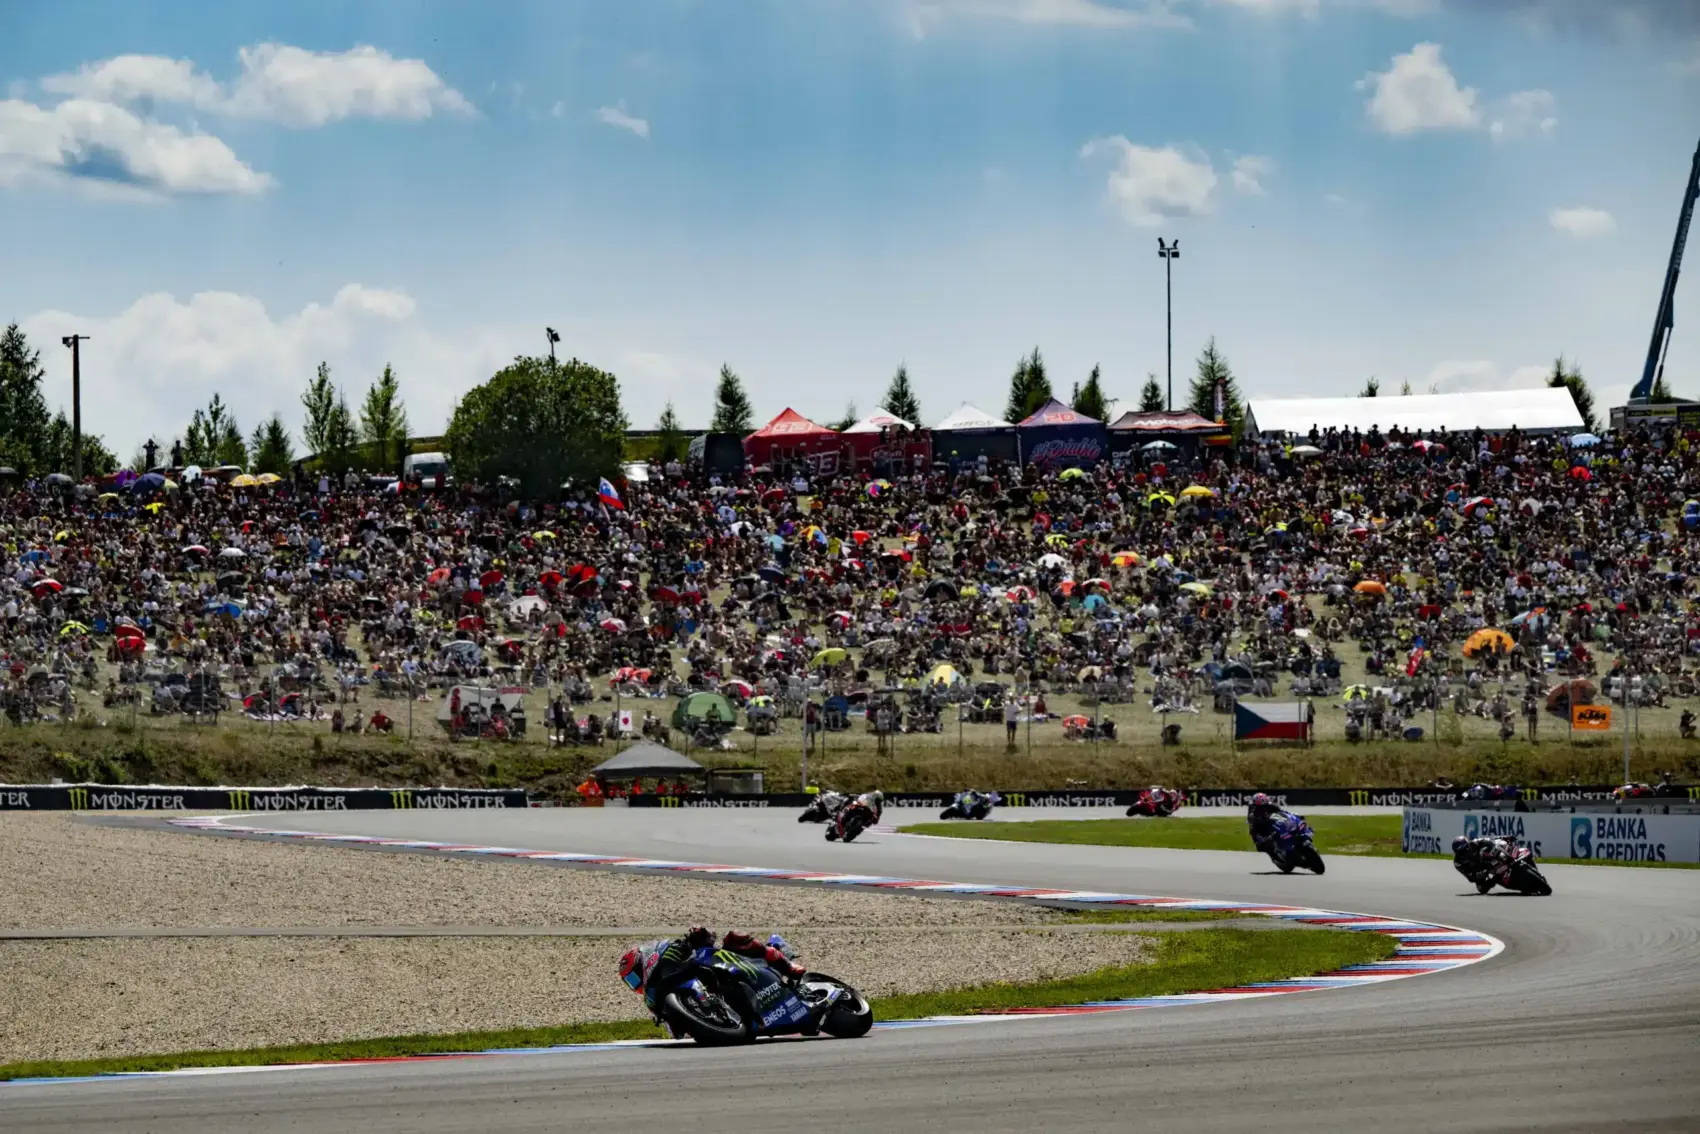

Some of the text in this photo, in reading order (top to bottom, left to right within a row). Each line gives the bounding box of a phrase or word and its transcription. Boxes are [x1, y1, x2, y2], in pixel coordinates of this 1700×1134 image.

[92, 792, 185, 809] MONSTER
[254, 792, 347, 810] MONSTER
[416, 793, 506, 809] MONSTER
[1029, 794, 1116, 807] MONSTER
[1201, 794, 1288, 807] MONSER
[1372, 792, 1457, 806] MONSTER
[1541, 789, 1616, 802] MONSTE
[1411, 811, 1432, 833] BANKA
[1481, 815, 1525, 837] BANKA
[1596, 817, 1647, 840] BANKA
[1411, 835, 1441, 855] CREDITAS
[1596, 843, 1666, 862] CREDITAS
[762, 1004, 787, 1027] ENEOS
